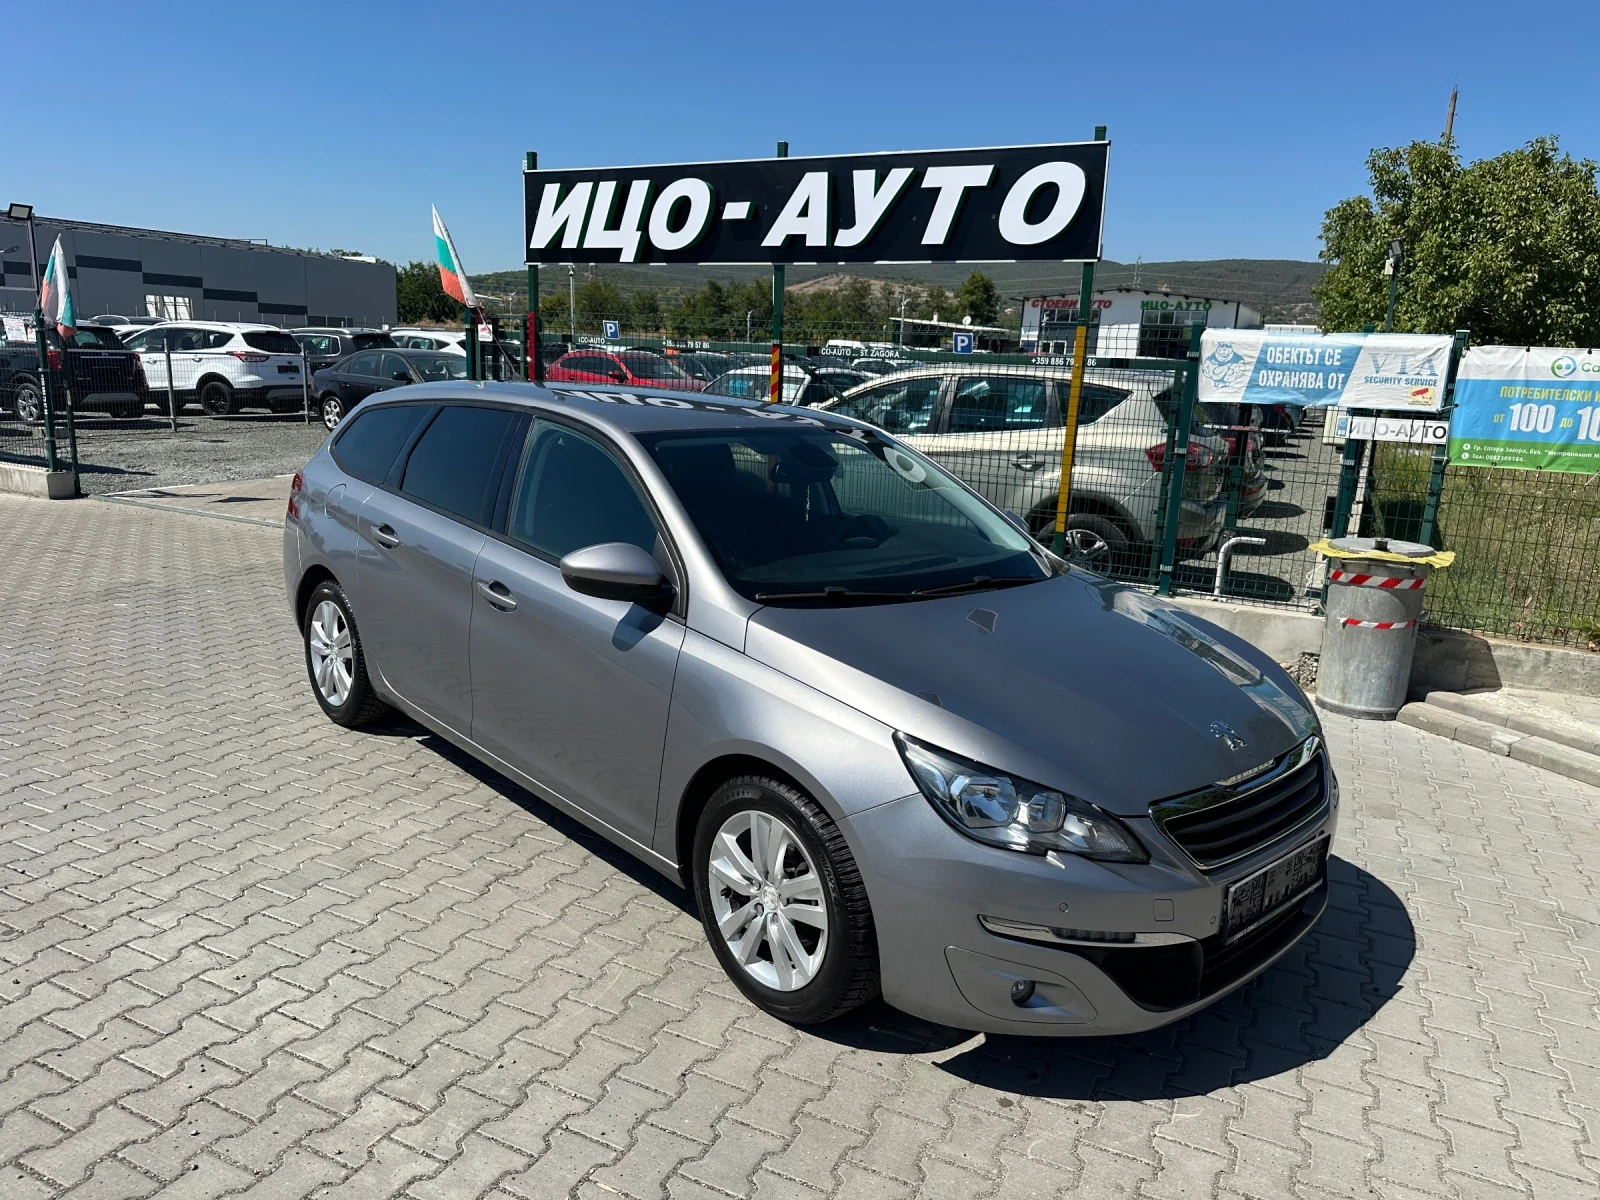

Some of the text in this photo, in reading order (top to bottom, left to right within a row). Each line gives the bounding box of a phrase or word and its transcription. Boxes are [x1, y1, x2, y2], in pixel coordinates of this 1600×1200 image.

[1140, 300, 1212, 311] ИЦО-АУТО
[606, 323, 616, 337] P
[957, 335, 969, 352] P
[870, 350, 900, 360] ZAGORA
[1031, 356, 1049, 365] +359
[1266, 346, 1342, 366] ОБЕКТЪТ СЕ
[1368, 353, 1439, 377] VTA
[1258, 369, 1346, 390] ОХРАНЯВА ОТ
[1364, 375, 1439, 387] SECURITY SERVICE
[1499, 386, 1593, 402] ПОТРЕБИТЕЛСКИ
[1509, 402, 1556, 434] 100
[1350, 421, 1447, 440] ИЦО-АУТО
